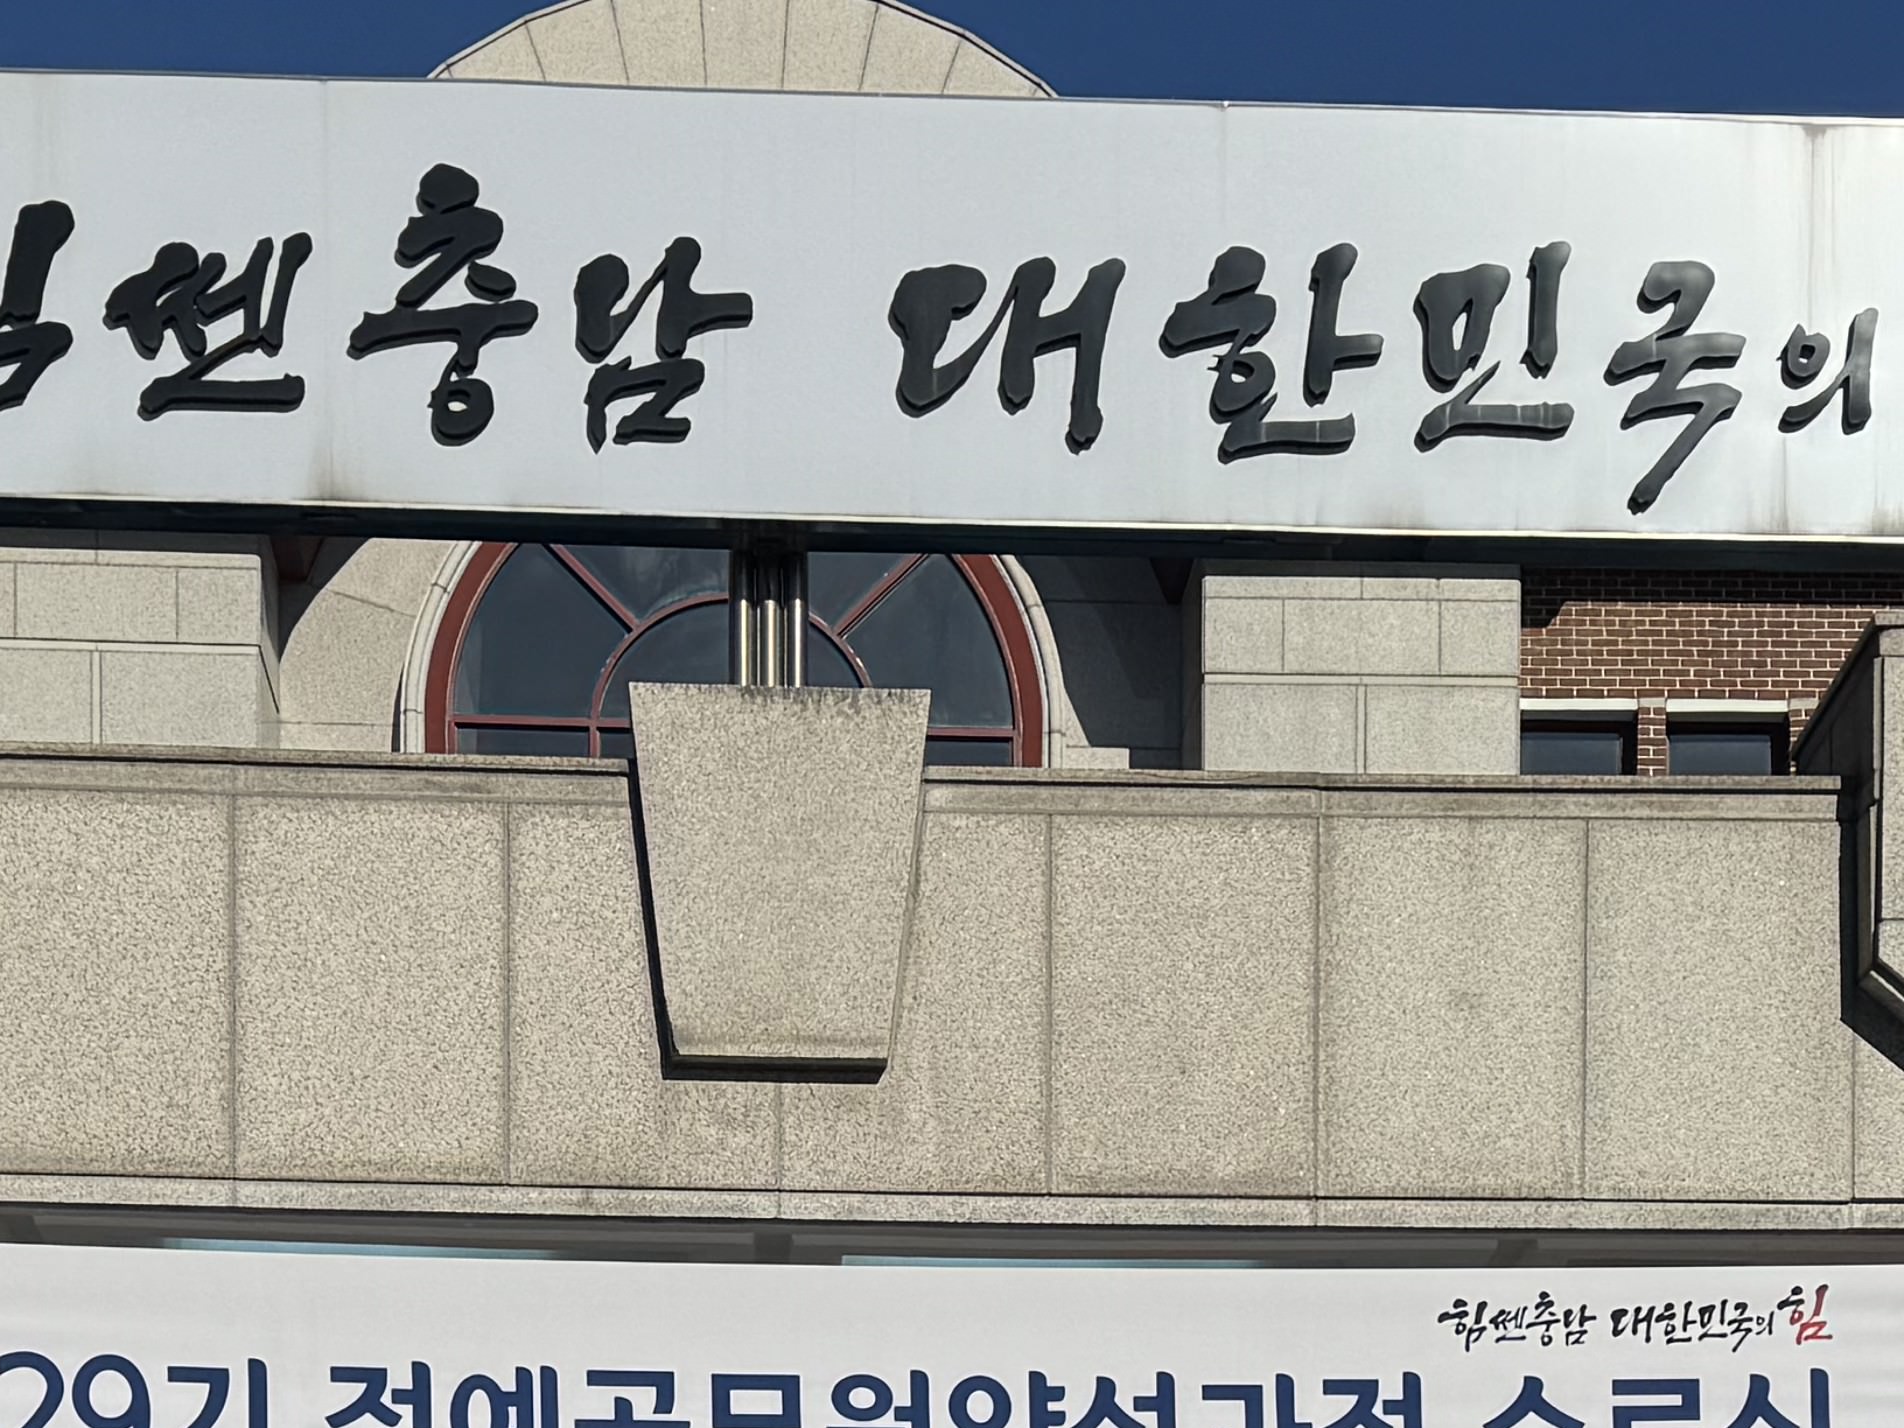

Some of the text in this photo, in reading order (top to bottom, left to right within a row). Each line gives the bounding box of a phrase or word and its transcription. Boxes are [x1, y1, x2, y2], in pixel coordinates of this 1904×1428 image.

[887, 241, 1874, 518] 대한민국의
[1437, 1283, 1834, 1353] 힘쎈충남 대한민국의 힘
